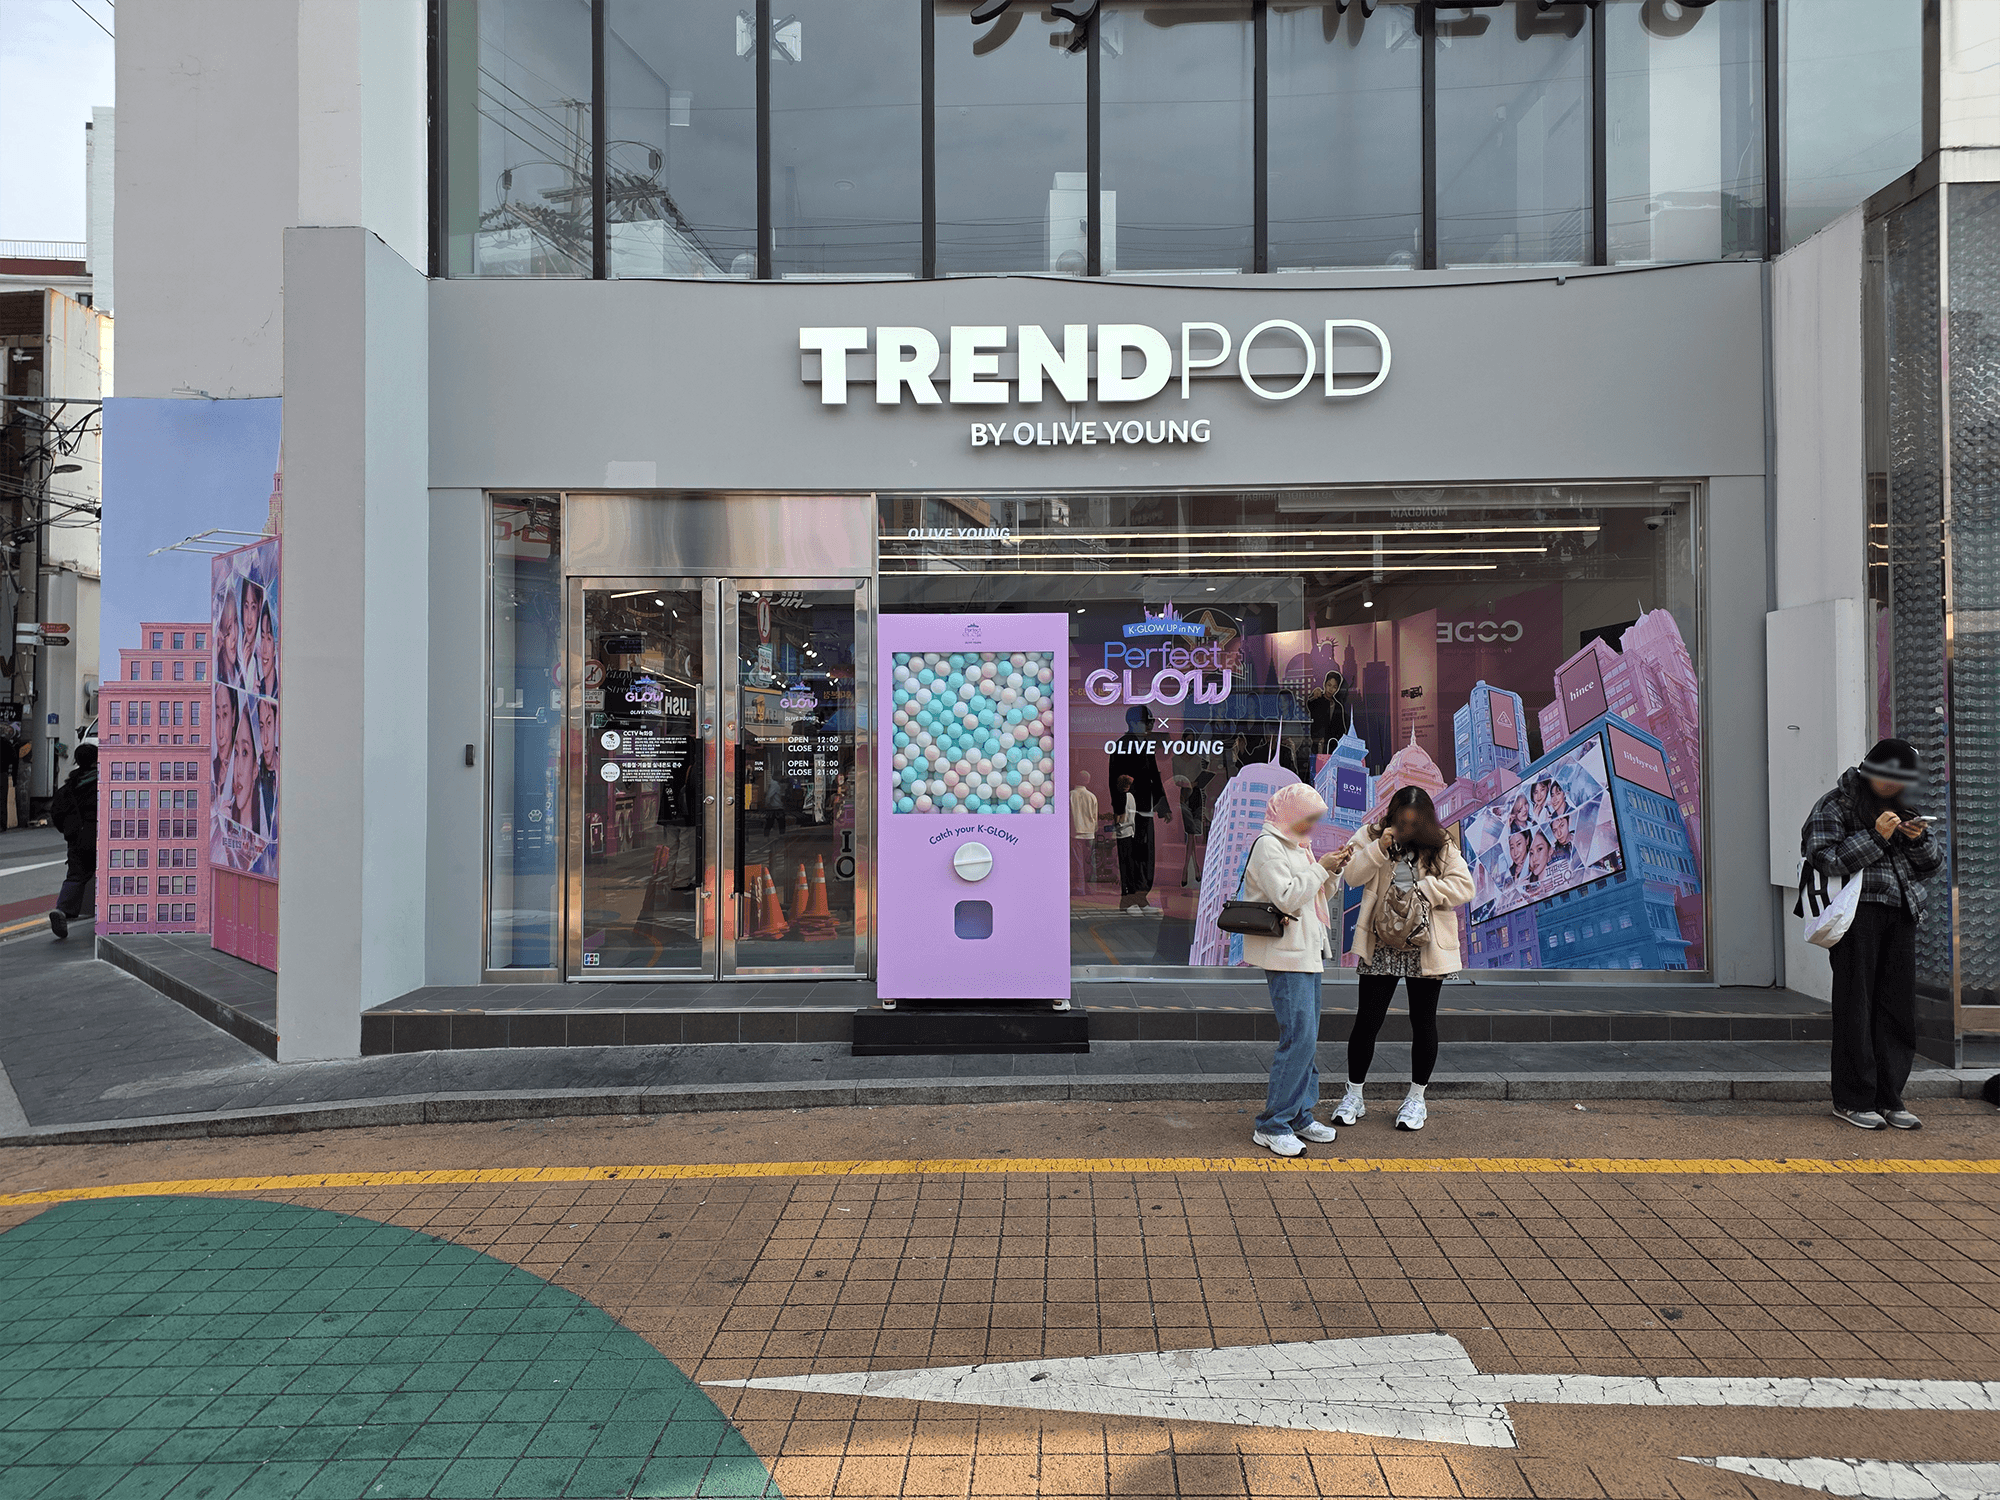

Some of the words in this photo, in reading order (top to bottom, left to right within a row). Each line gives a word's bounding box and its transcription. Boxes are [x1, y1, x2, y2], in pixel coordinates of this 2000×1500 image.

[971, 423, 1006, 446] BY
[1013, 421, 1097, 446] OLIVE
[1103, 419, 1211, 444] YOUNG
[908, 527, 953, 540] OLIVE
[957, 527, 1011, 540] YOUNG
[1104, 641, 1223, 669] Perfect
[625, 691, 664, 702] GLOW
[1084, 668, 1232, 706] GLOW
[1569, 681, 1595, 702] hince
[780, 698, 818, 708] GLOW
[1104, 740, 1157, 755] OLIVE
[1161, 740, 1224, 755] YOUNG
[1623, 750, 1659, 773] lilybyred
[929, 828, 953, 845] Catch
[954, 826, 975, 837] your
[977, 824, 1019, 846] K-GLOW!
